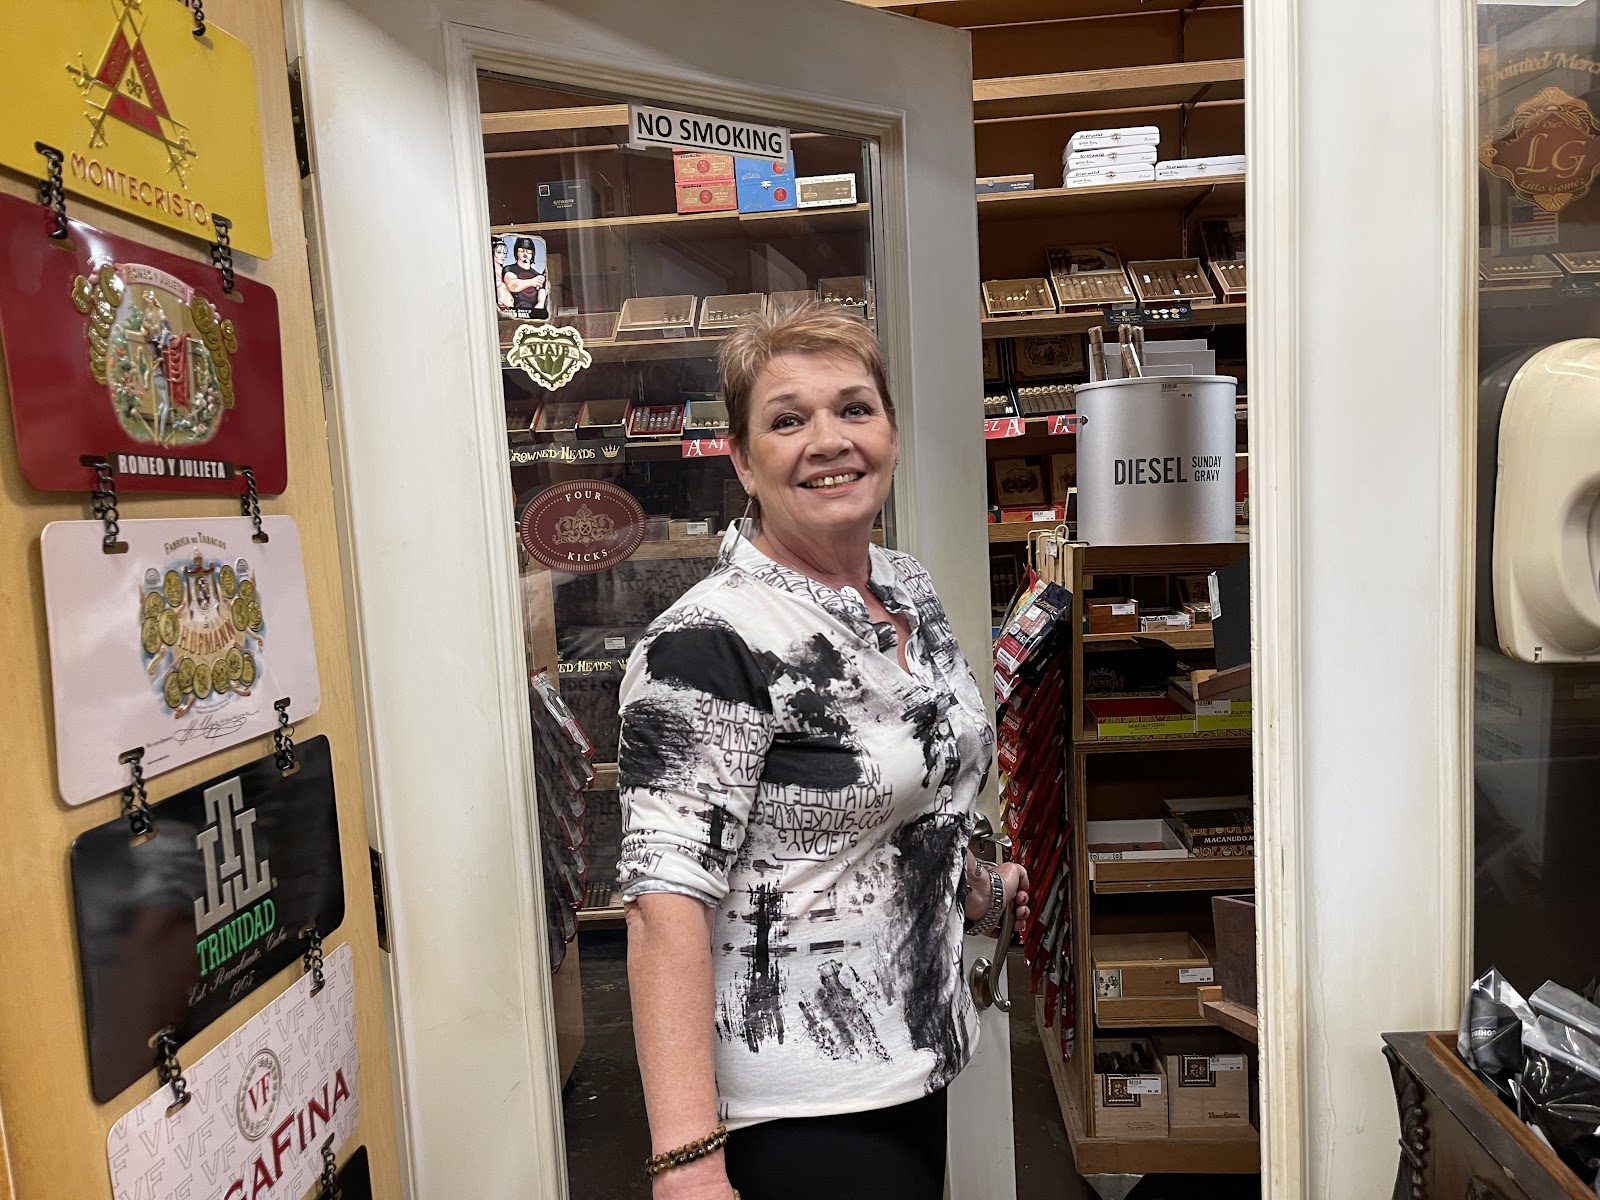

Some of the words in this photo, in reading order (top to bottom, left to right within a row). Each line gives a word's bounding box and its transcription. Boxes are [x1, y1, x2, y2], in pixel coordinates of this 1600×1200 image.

[636, 111, 673, 139] NO
[679, 118, 783, 155] SMOKING
[1515, 133, 1587, 179] LG
[70, 151, 209, 228] MONTECRISTO
[527, 344, 570, 357] VIAJE
[708, 438, 724, 451] AJ
[118, 455, 165, 476] ROMEO
[168, 458, 175, 476] Y
[179, 459, 226, 479] JULIETA
[1114, 457, 1188, 485] DIESEL
[1191, 456, 1222, 468] SUNDAY
[1194, 470, 1220, 482] GRAVY
[565, 490, 603, 503] FOUR
[567, 548, 609, 562] KICKS
[1203, 835, 1248, 844] MACANUDO
[196, 898, 277, 977] TRINIDAD
[247, 1071, 271, 1114] VF
